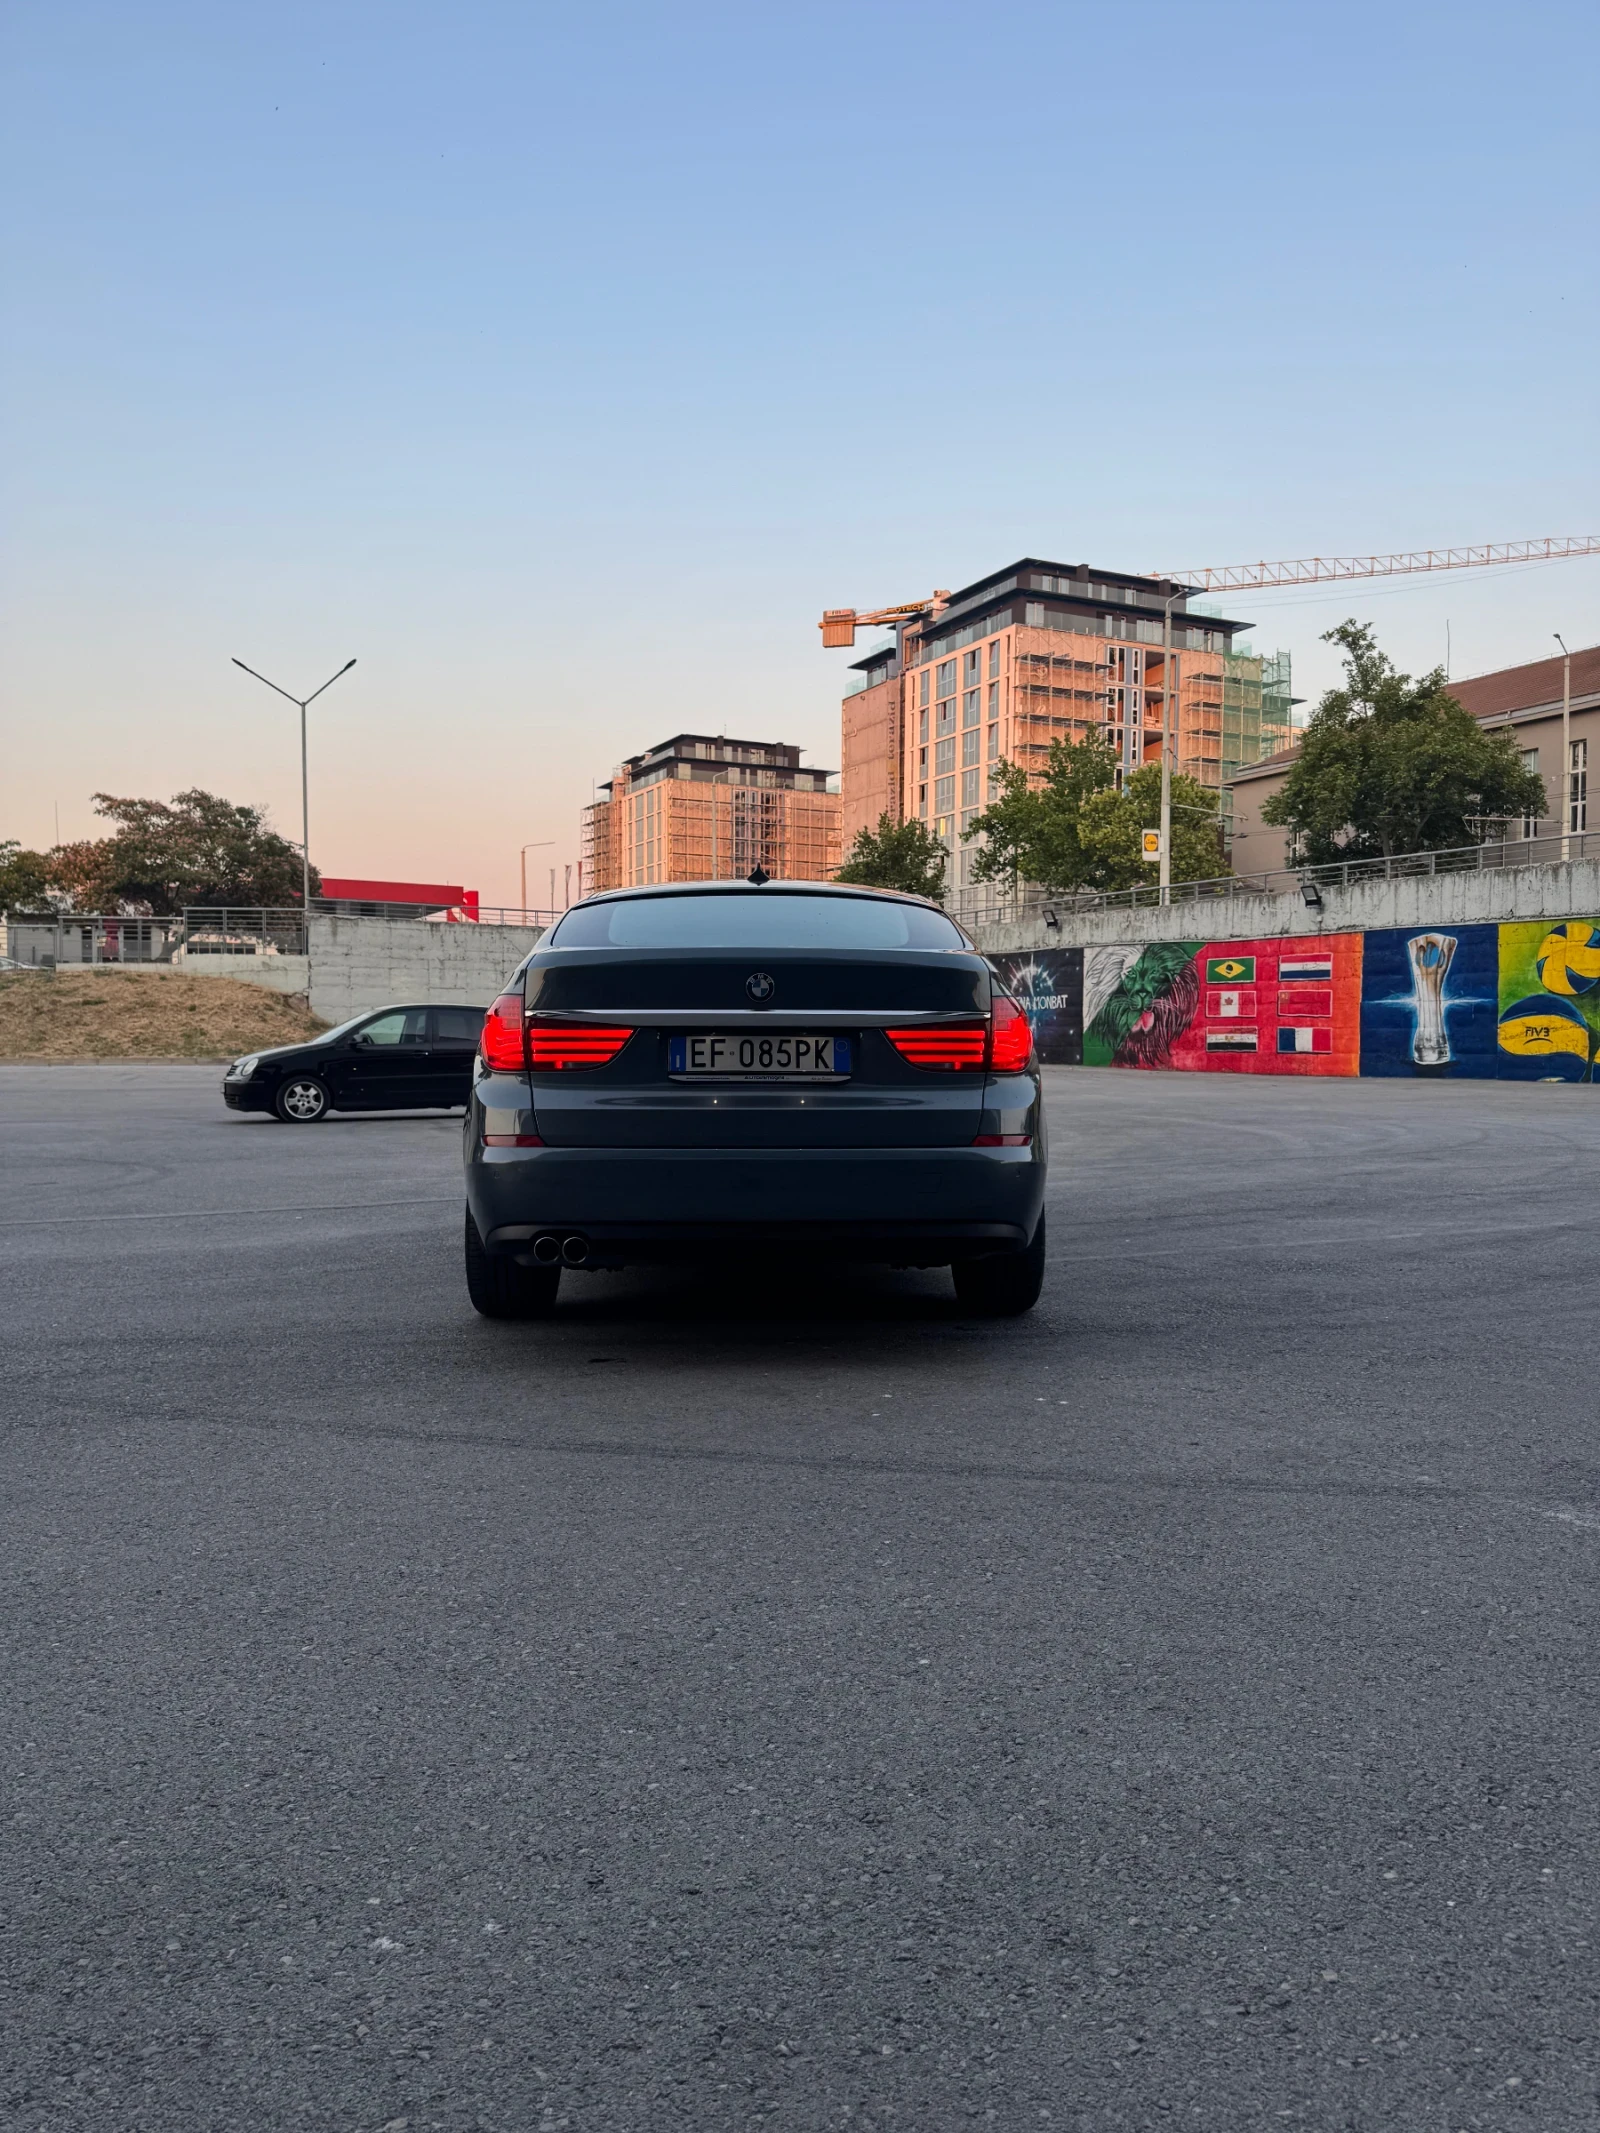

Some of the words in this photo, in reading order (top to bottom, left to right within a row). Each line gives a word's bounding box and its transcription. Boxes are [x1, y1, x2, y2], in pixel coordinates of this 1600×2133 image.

[1033, 994, 1068, 1011] MONBAT
[691, 1038, 726, 1068] EF
[739, 1039, 830, 1069] 085PK
